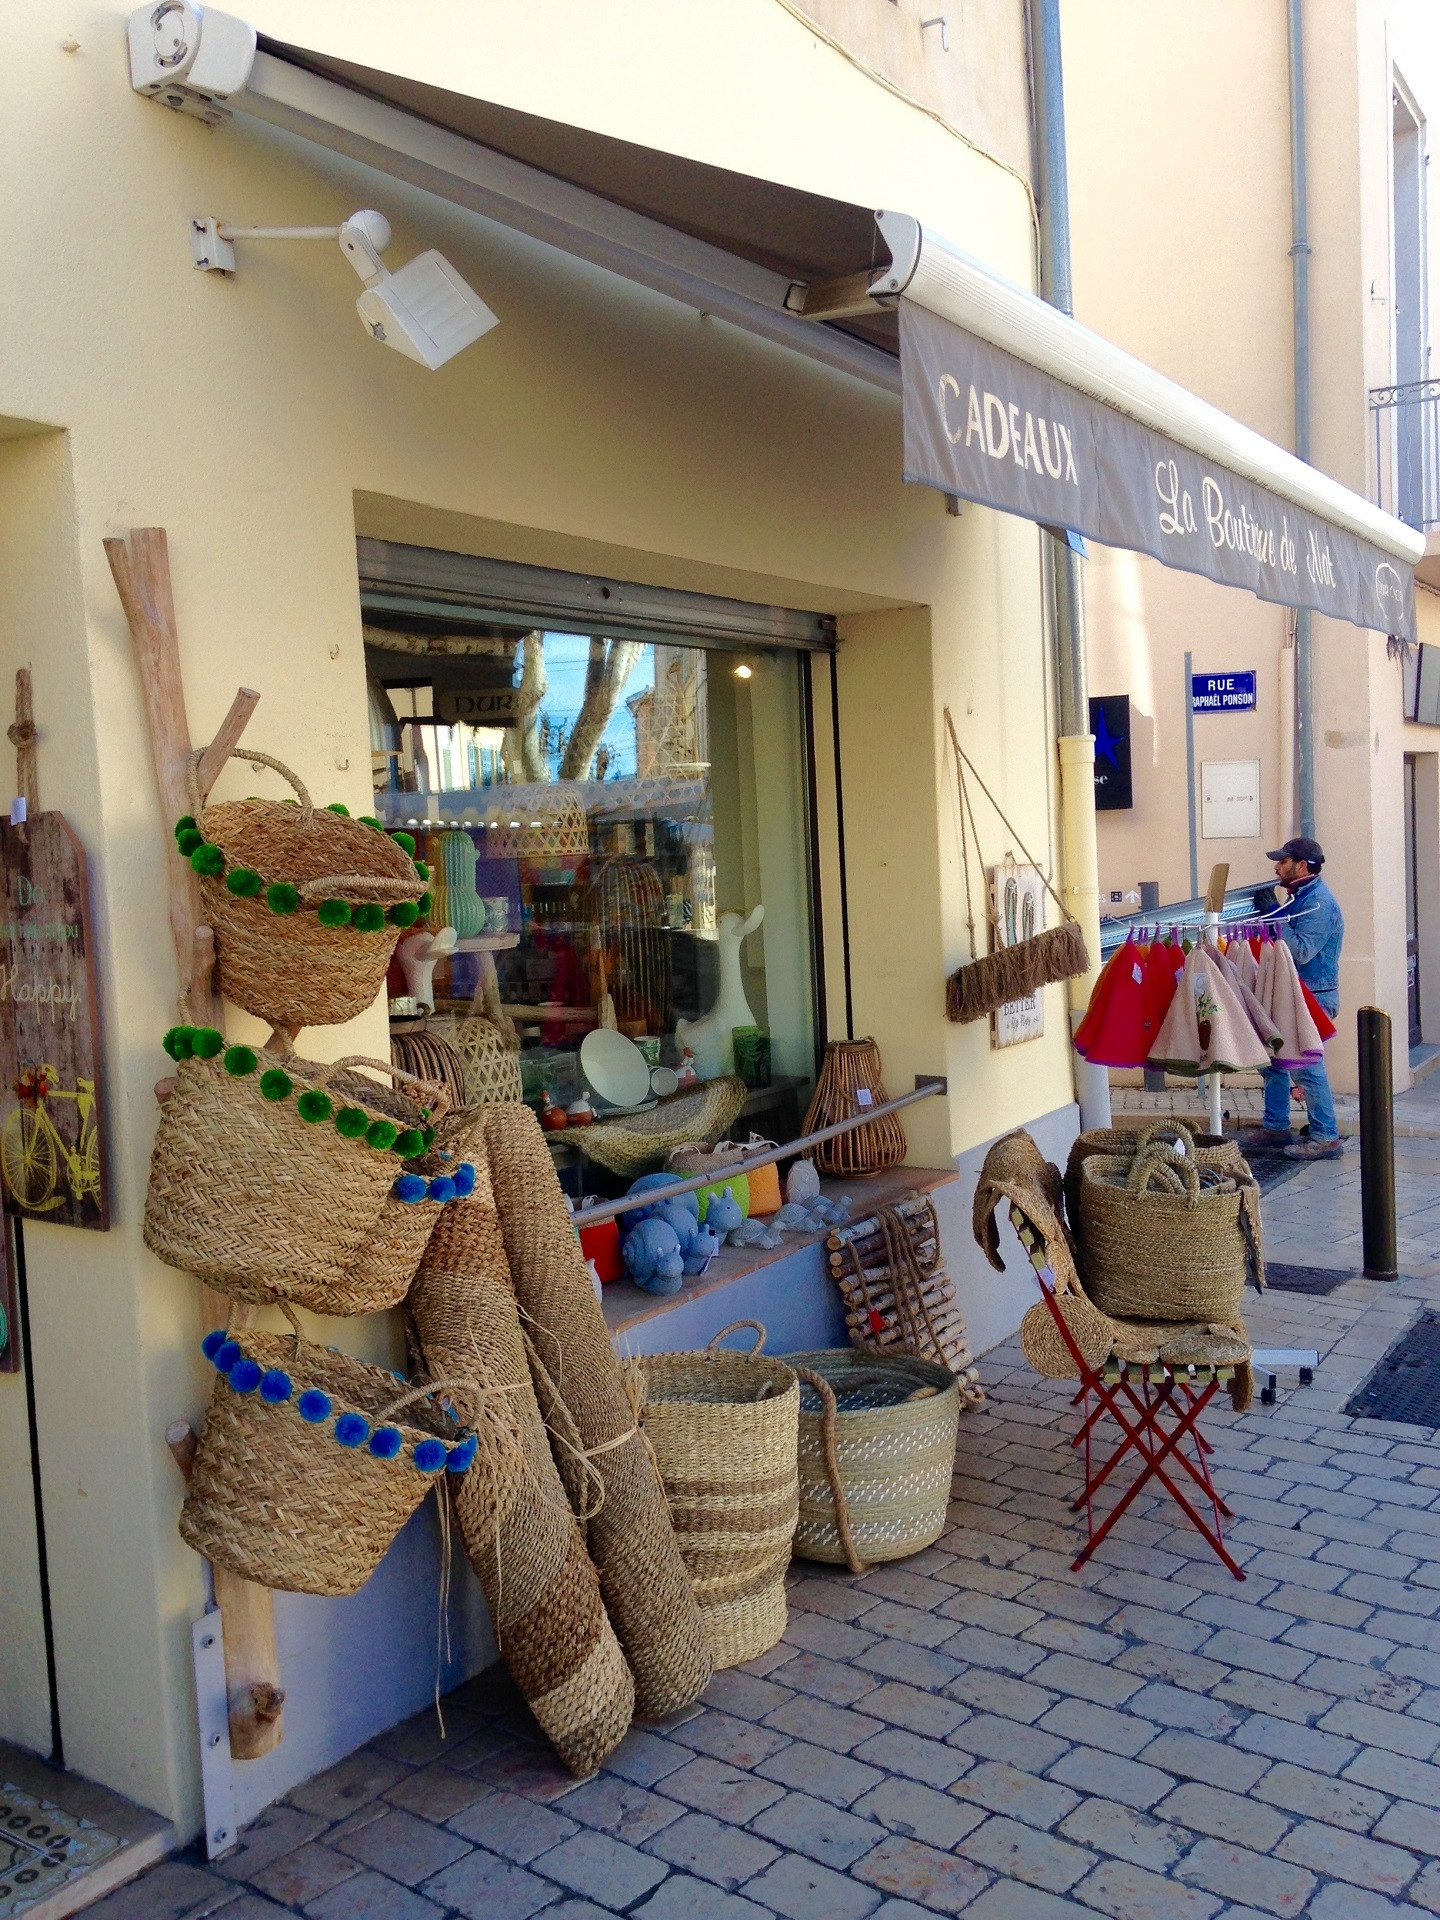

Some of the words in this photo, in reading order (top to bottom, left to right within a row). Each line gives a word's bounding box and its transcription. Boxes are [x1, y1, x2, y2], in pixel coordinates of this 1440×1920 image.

[939, 373, 1078, 486] CADEAUX
[1155, 459, 1198, 536] La
[1280, 515, 1297, 575] de
[1207, 678, 1235, 692] RUE
[1222, 692, 1253, 706] PONSON
[1094, 775, 1108, 785] se
[1003, 995, 1037, 1016] BETTER
